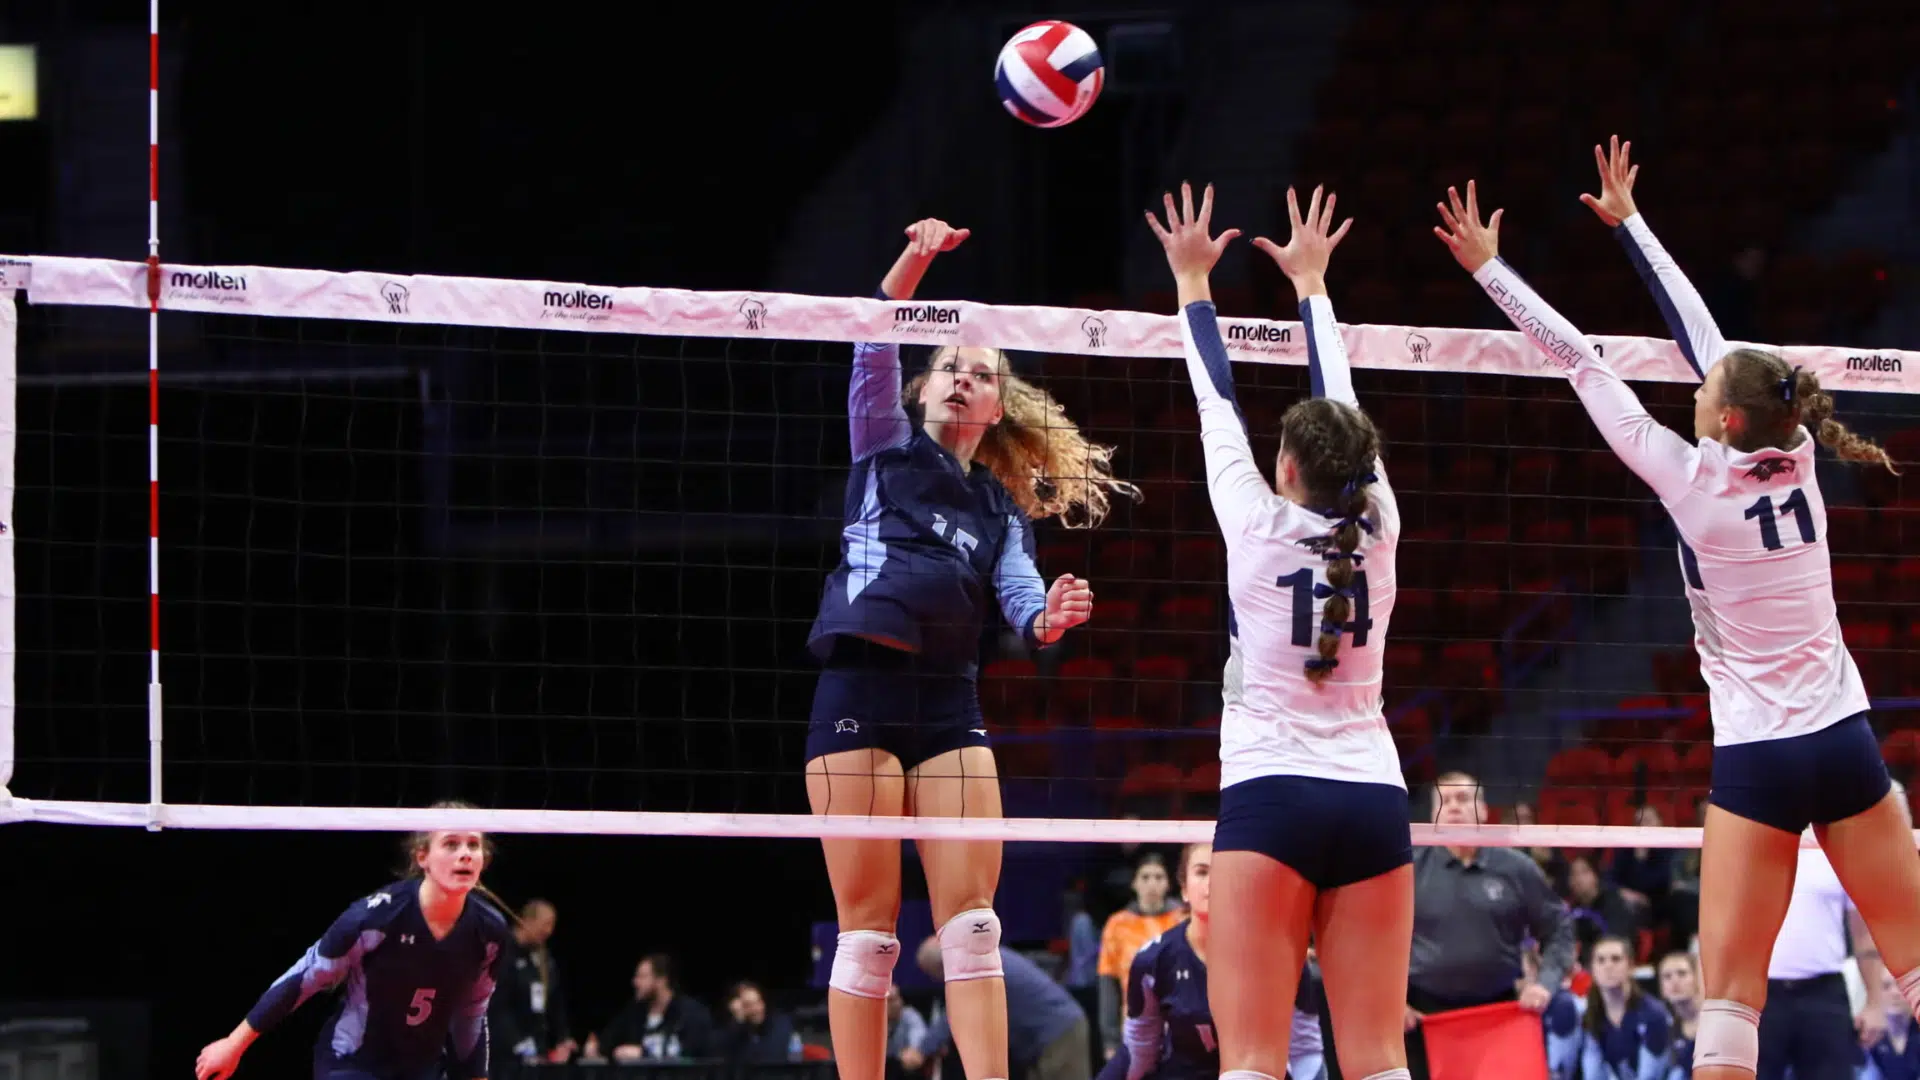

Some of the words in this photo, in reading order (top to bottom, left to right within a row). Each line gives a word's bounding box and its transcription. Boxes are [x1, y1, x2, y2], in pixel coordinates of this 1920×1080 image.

[171, 271, 247, 291] molten
[543, 290, 614, 310] molten
[894, 305, 961, 324] molten
[1487, 278, 1583, 369] HAWKS
[1228, 324, 1292, 343] molten
[1846, 355, 1903, 373] molten
[1744, 488, 1816, 551] 11
[406, 988, 437, 1026] 5
